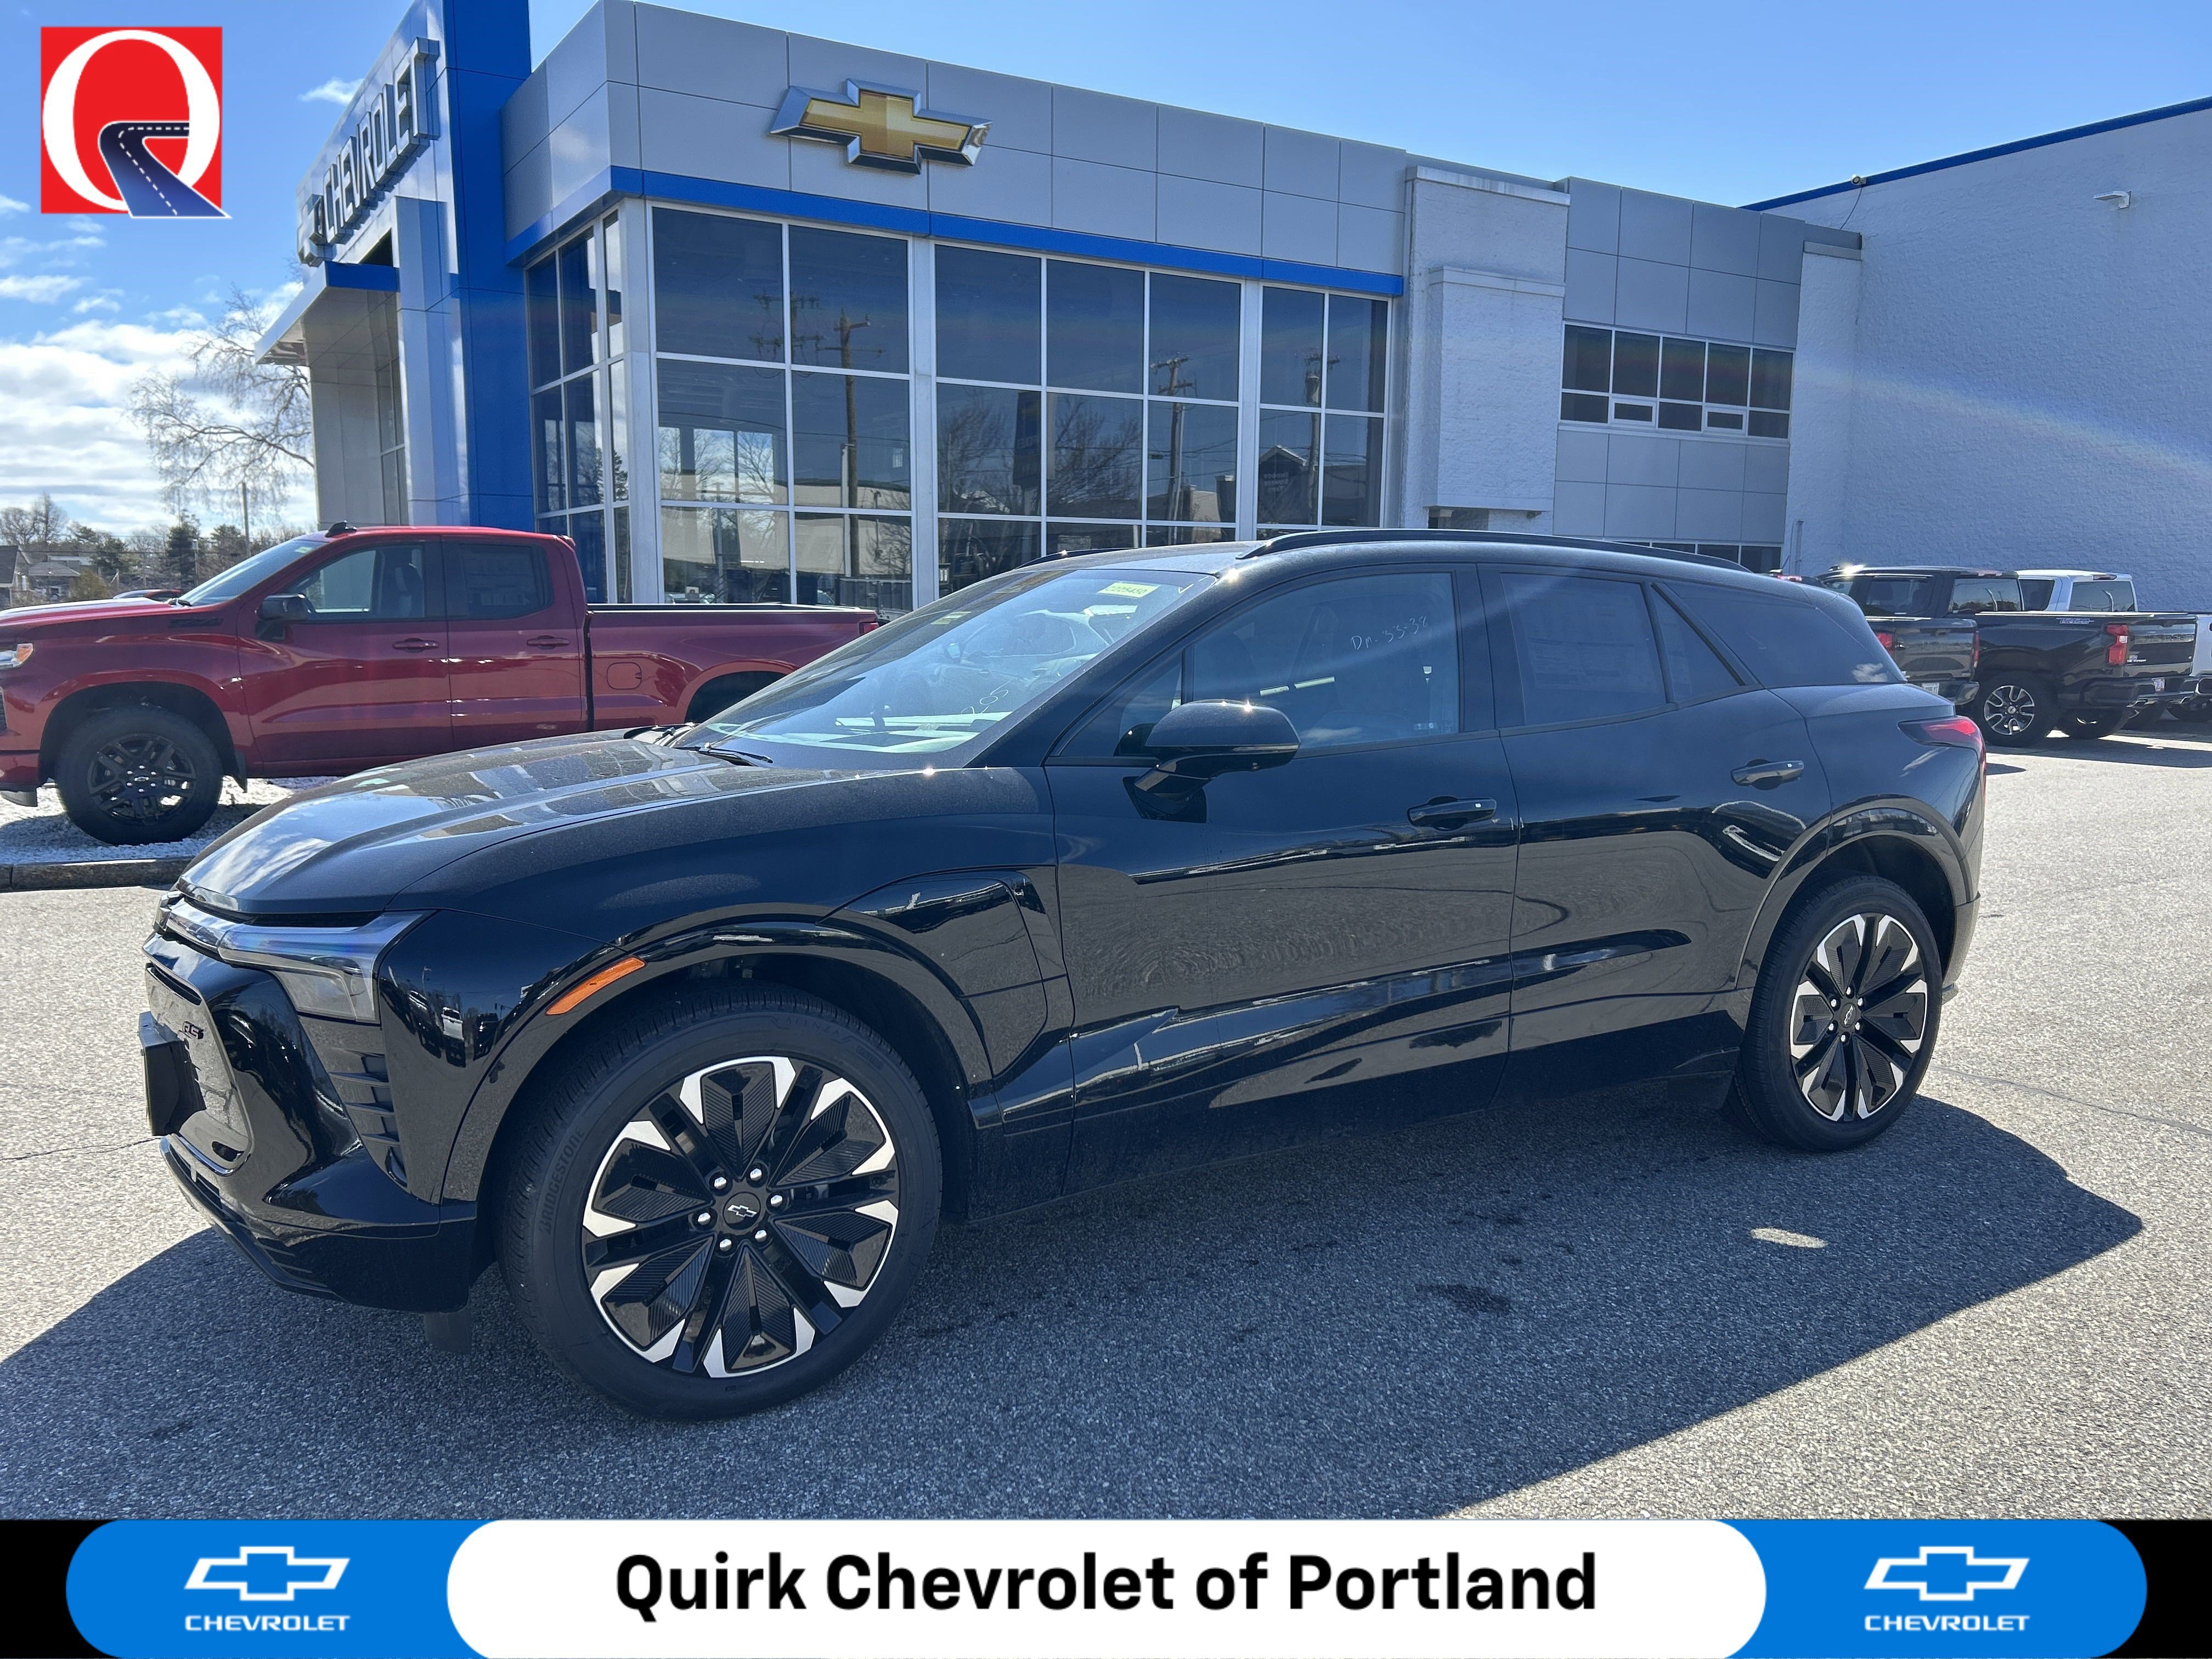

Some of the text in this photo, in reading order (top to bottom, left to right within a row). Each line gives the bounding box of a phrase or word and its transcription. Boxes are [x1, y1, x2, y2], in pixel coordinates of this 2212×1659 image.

[323, 37, 439, 245] CHEVROLET
[182, 1020, 204, 1040] RS
[538, 1126, 585, 1234] BRIDGESTONE
